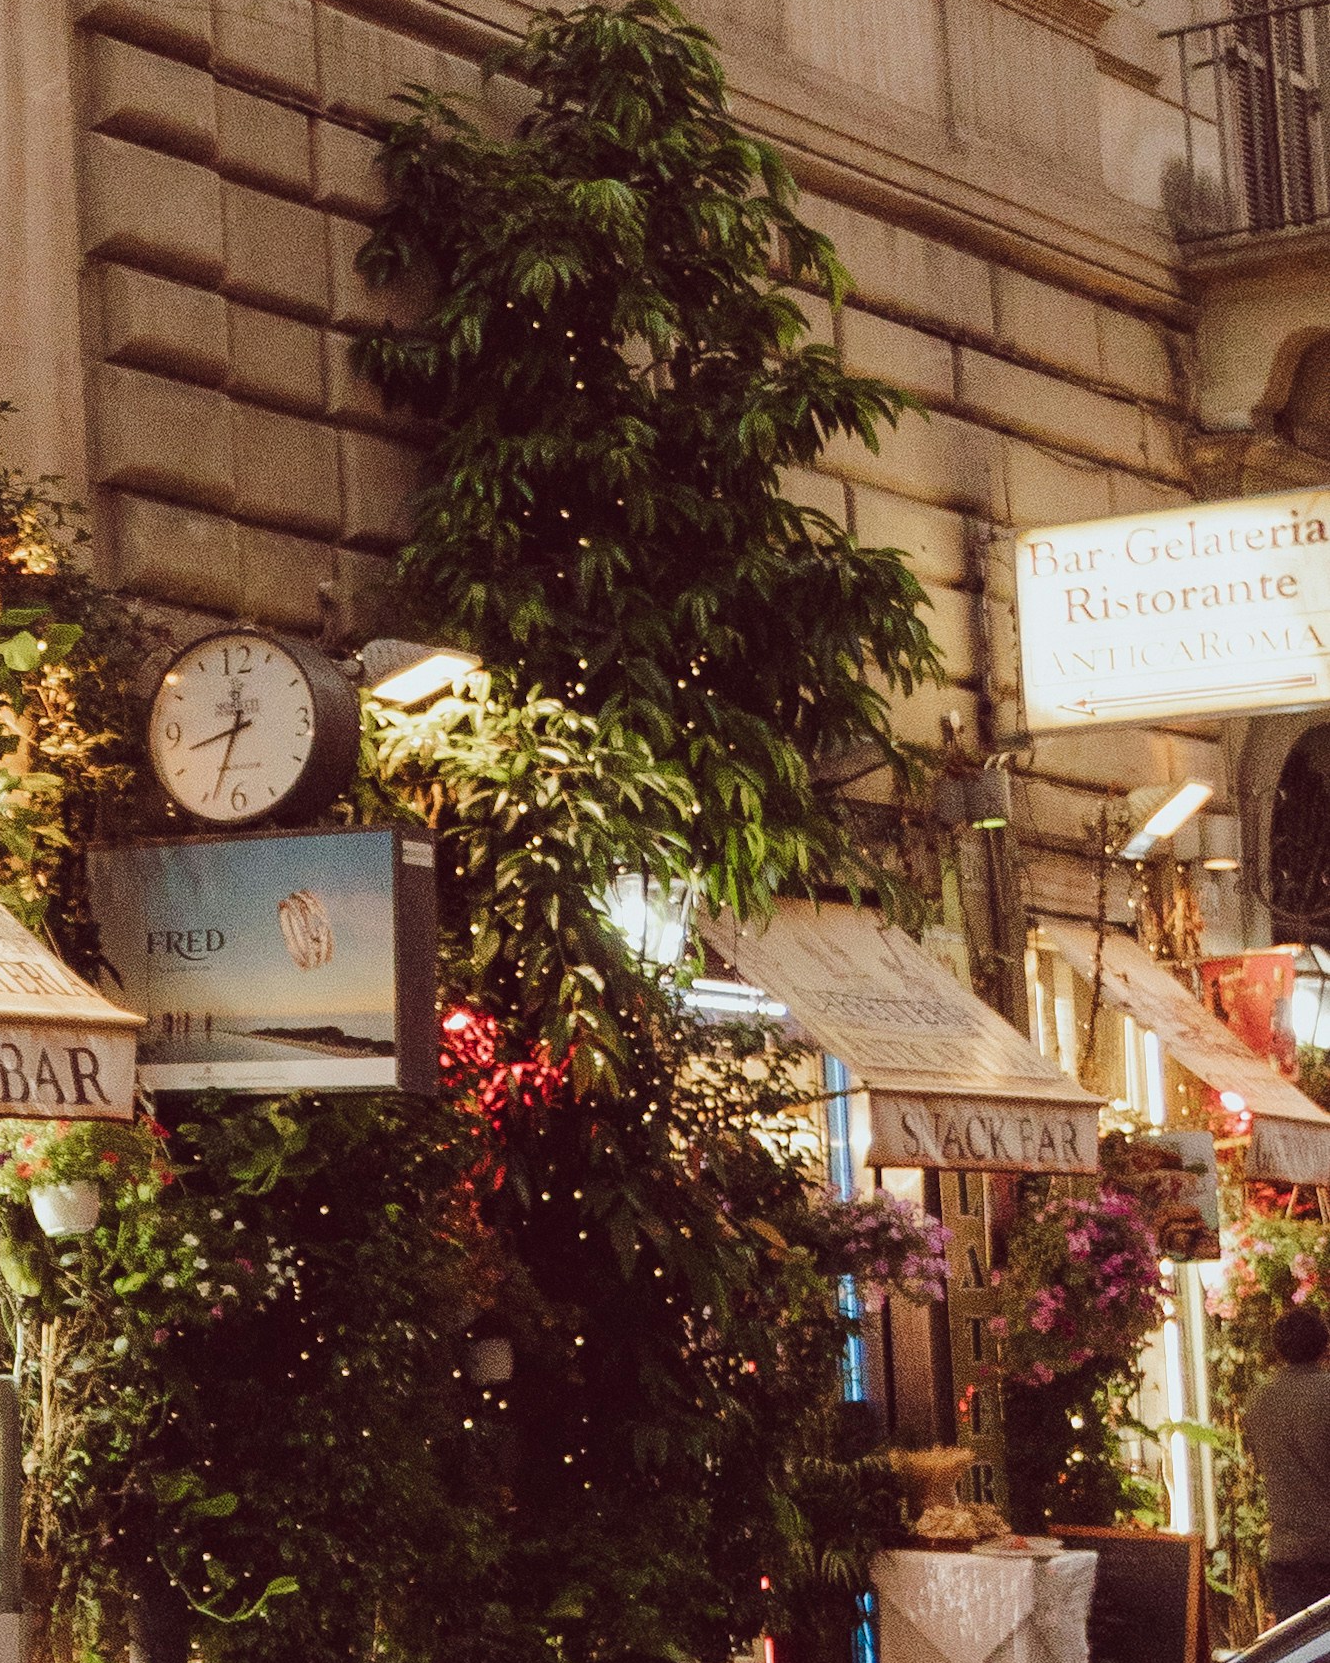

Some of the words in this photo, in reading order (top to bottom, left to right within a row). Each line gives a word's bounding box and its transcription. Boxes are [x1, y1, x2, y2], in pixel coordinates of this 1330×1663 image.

[1064, 572, 1299, 624] Ristorante
[220, 644, 252, 676] 12
[165, 722, 181, 749] 9
[295, 706, 310, 737] 3
[231, 783, 247, 812] 6
[147, 928, 224, 961] FRED
